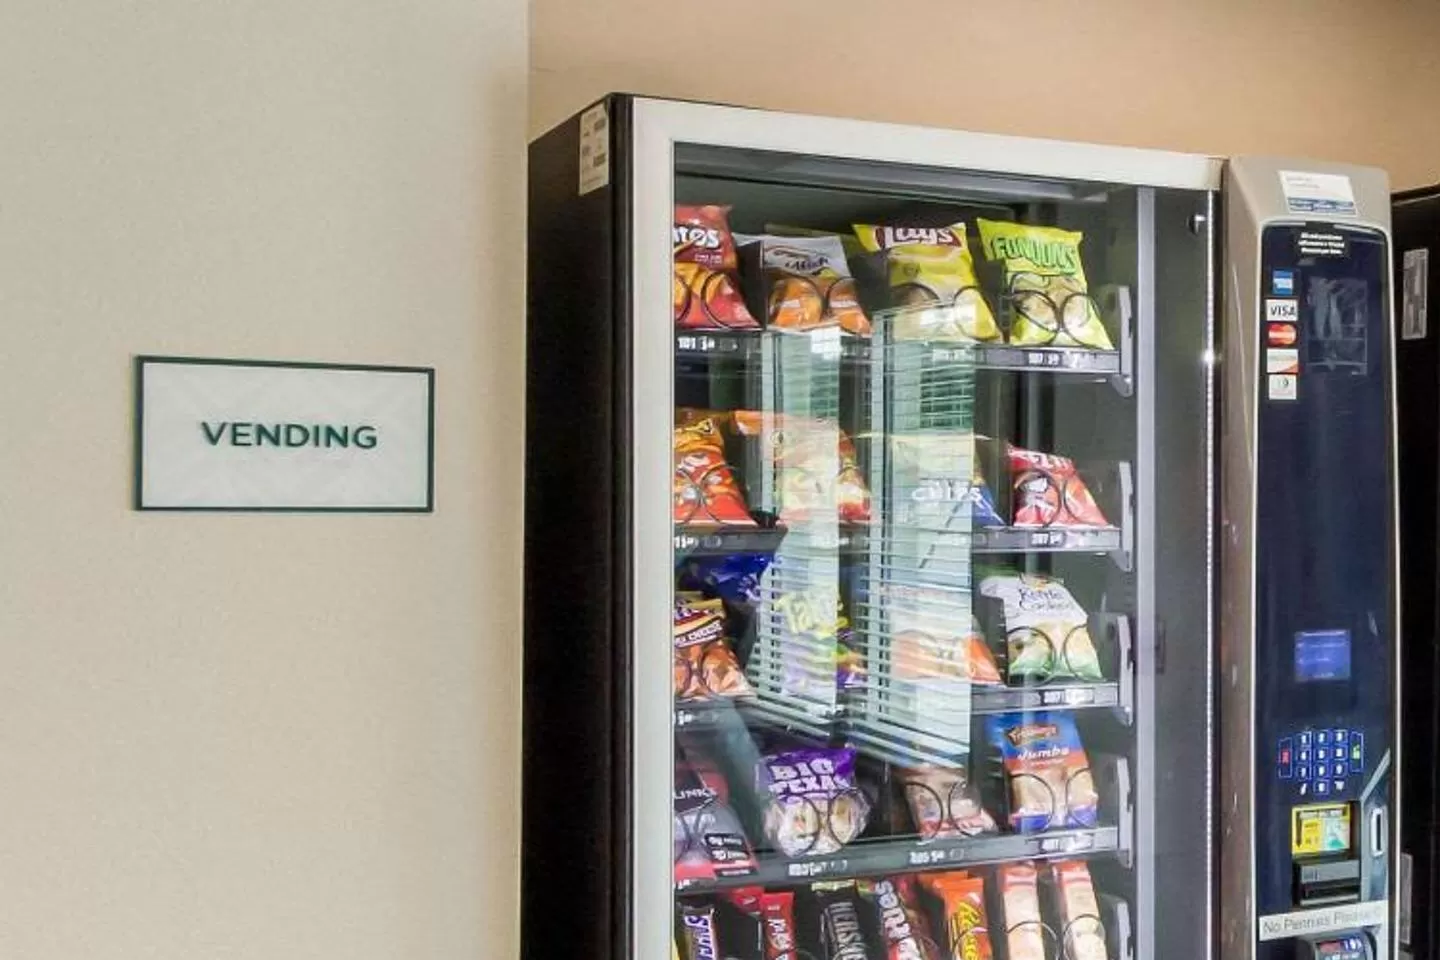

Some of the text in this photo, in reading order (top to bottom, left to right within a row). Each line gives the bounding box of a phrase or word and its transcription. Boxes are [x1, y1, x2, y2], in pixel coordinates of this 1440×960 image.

[1270, 304, 1297, 317] VISA
[201, 421, 379, 450] VENDING
[768, 758, 834, 781] BIG
